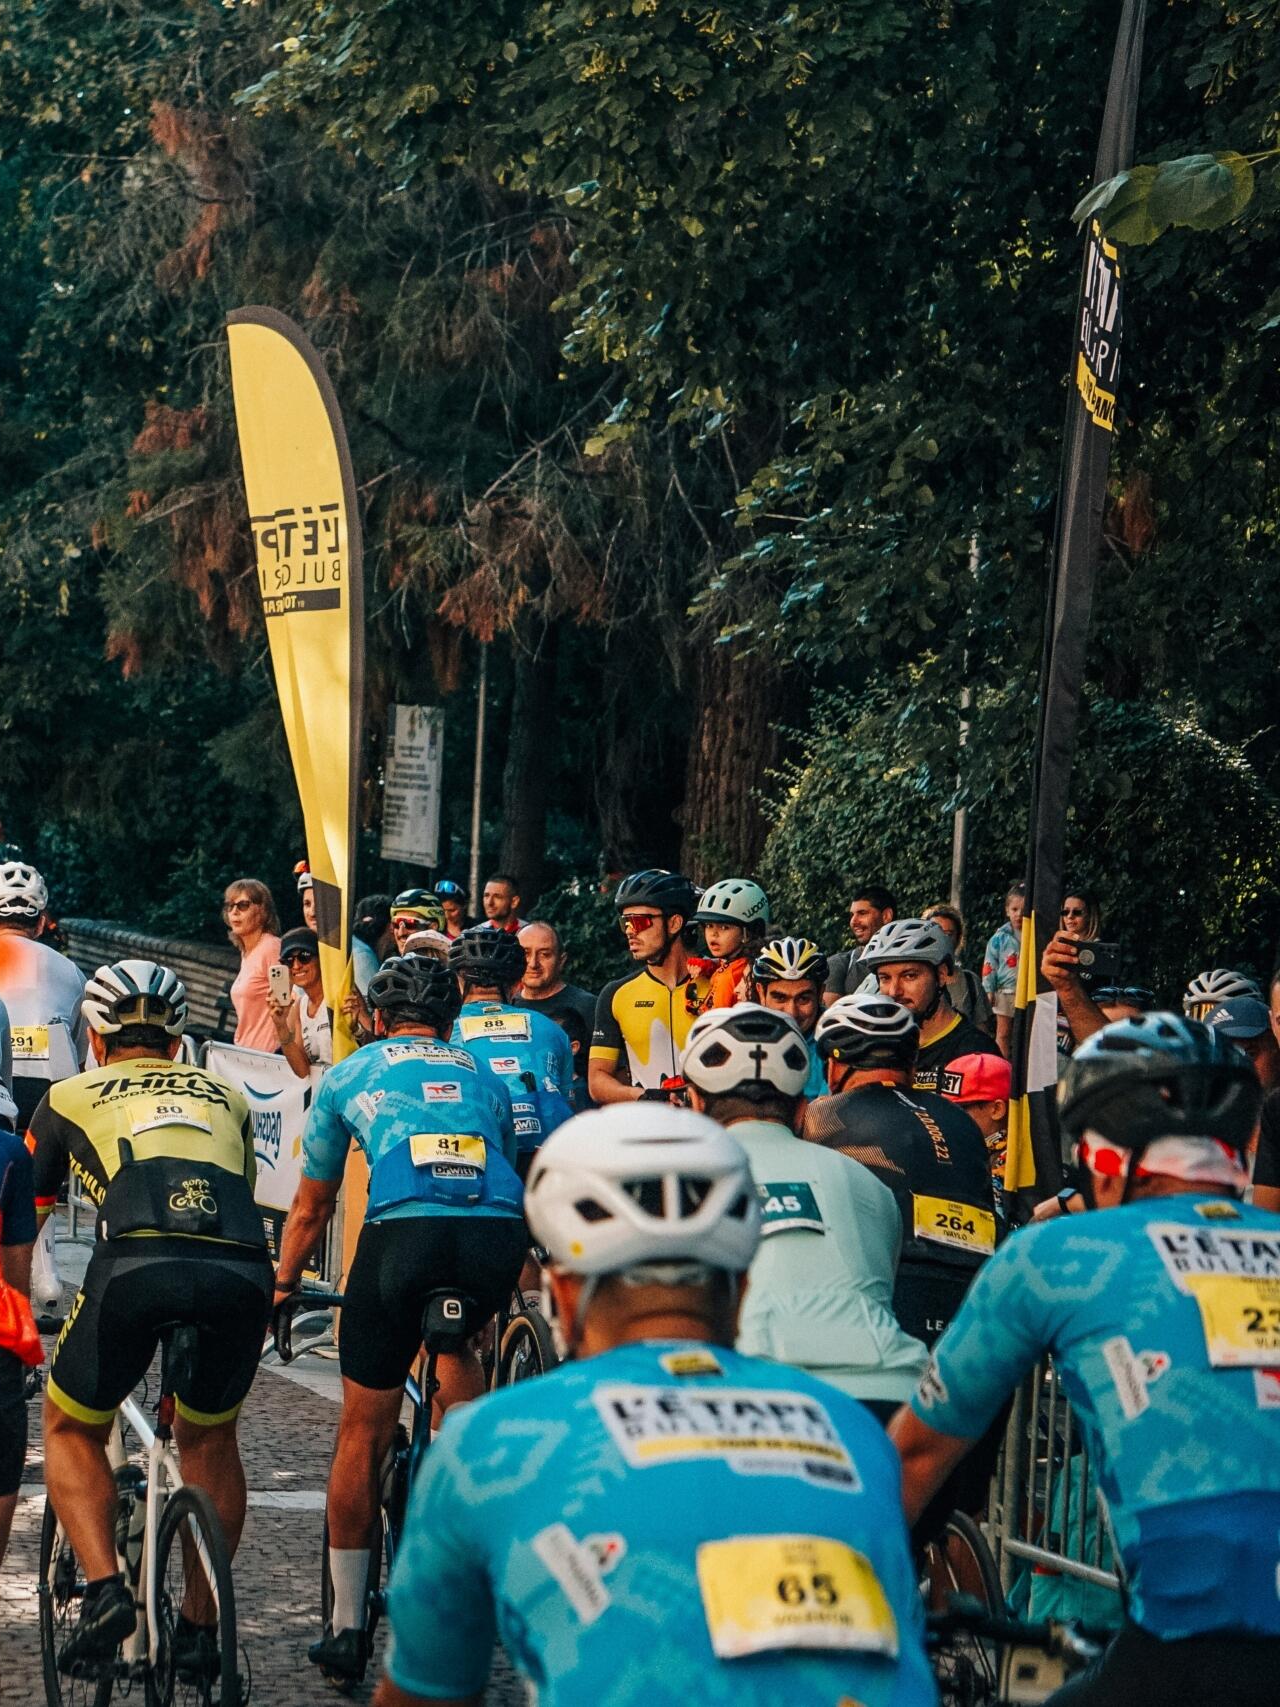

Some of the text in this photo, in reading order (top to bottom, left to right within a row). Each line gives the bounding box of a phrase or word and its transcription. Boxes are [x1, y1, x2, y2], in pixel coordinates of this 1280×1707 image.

[484, 1019, 504, 1028] 88
[10, 1036, 33, 1047] 291
[92, 1088, 156, 1109] PLOVDIV
[156, 1105, 183, 1114] 80
[438, 1138, 460, 1152] 81
[935, 1213, 976, 1235] 264
[1161, 1230, 1280, 1259] L'ÉTA
[776, 1572, 838, 1605] 65
